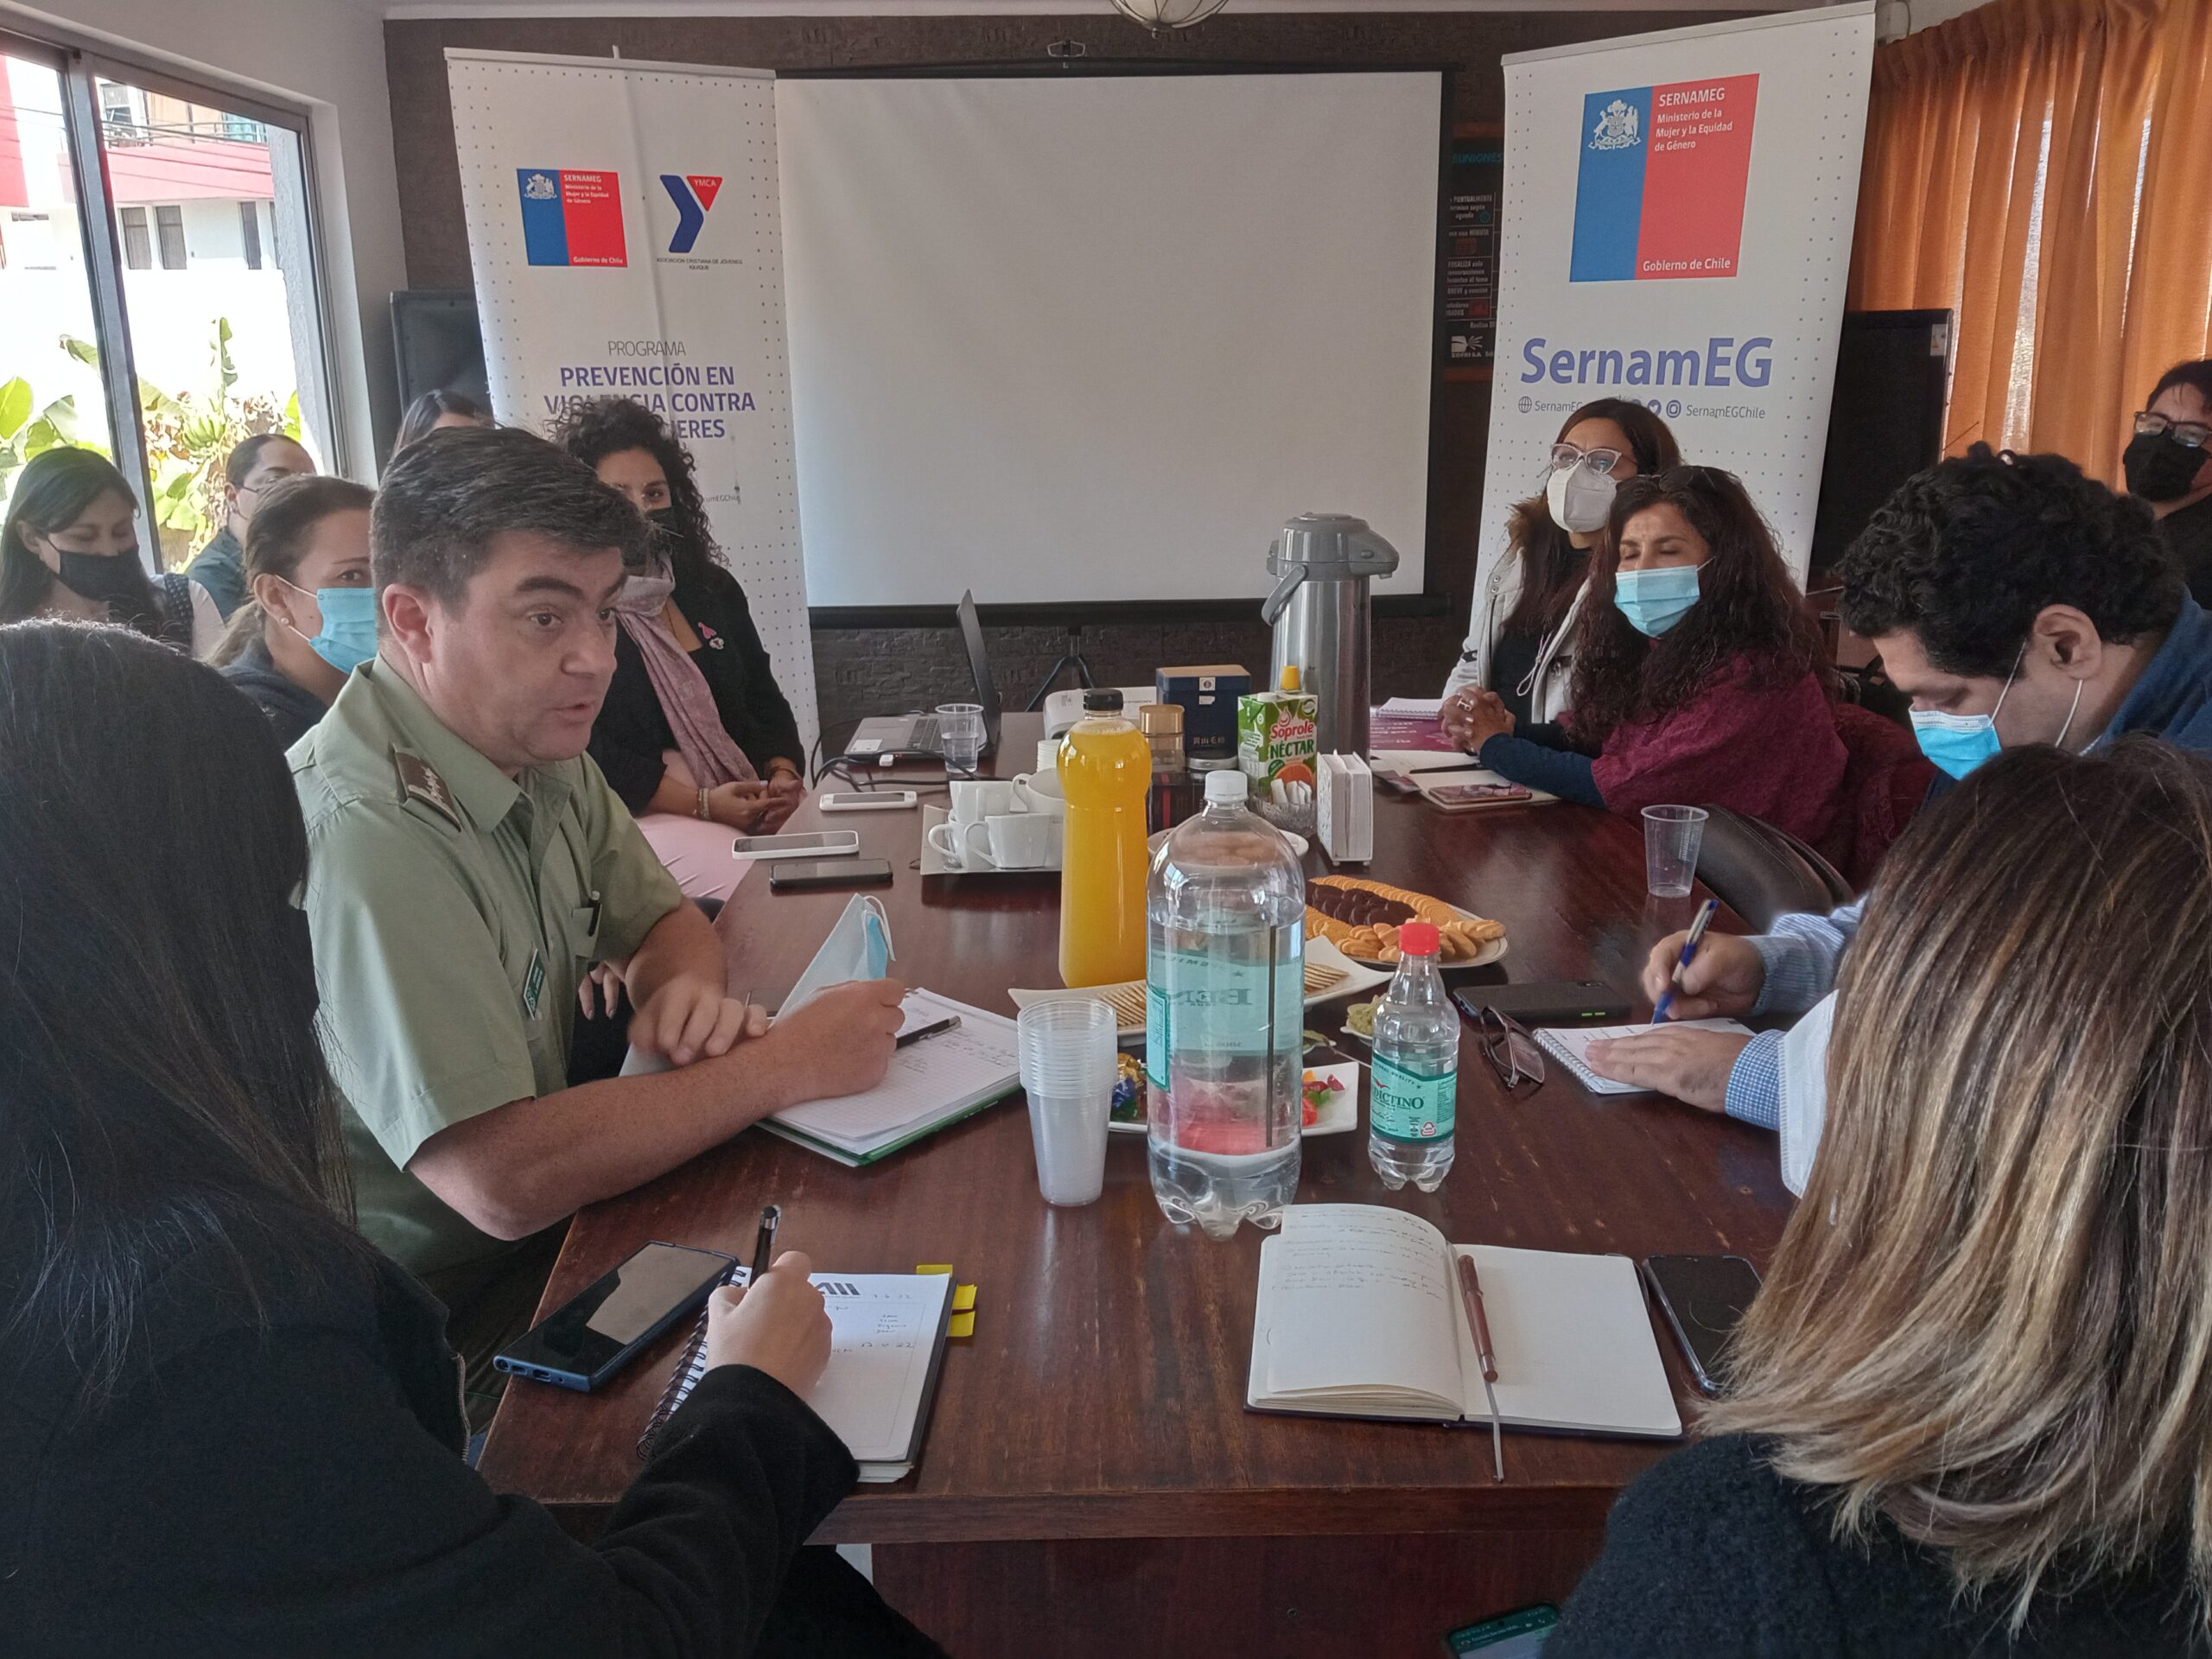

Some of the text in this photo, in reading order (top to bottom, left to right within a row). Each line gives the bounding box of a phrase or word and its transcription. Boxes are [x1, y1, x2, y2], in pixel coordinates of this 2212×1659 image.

[1658, 87, 1726, 107] SERNAMEG
[1656, 108, 1722, 124] Ministerio de la
[1656, 121, 1733, 138] Mujer y la Equidad
[1654, 140, 1696, 152] de Género
[1452, 152, 1503, 163] EUNIONES
[563, 174, 602, 183] SERNAMEG
[694, 179, 717, 188] YMCA
[1643, 257, 1731, 271] Gobierno de Chile
[607, 340, 687, 356] PROGRAMA
[1520, 337, 1773, 387] SernamEG
[560, 363, 734, 387] PREVENCIÓN EN
[671, 392, 756, 412] CONTRA
[1686, 404, 1766, 418] SernamEGChile
[676, 419, 726, 439] ERES
[1271, 722, 1313, 741] Soprole
[1270, 739, 1314, 760] NÉCTAR
